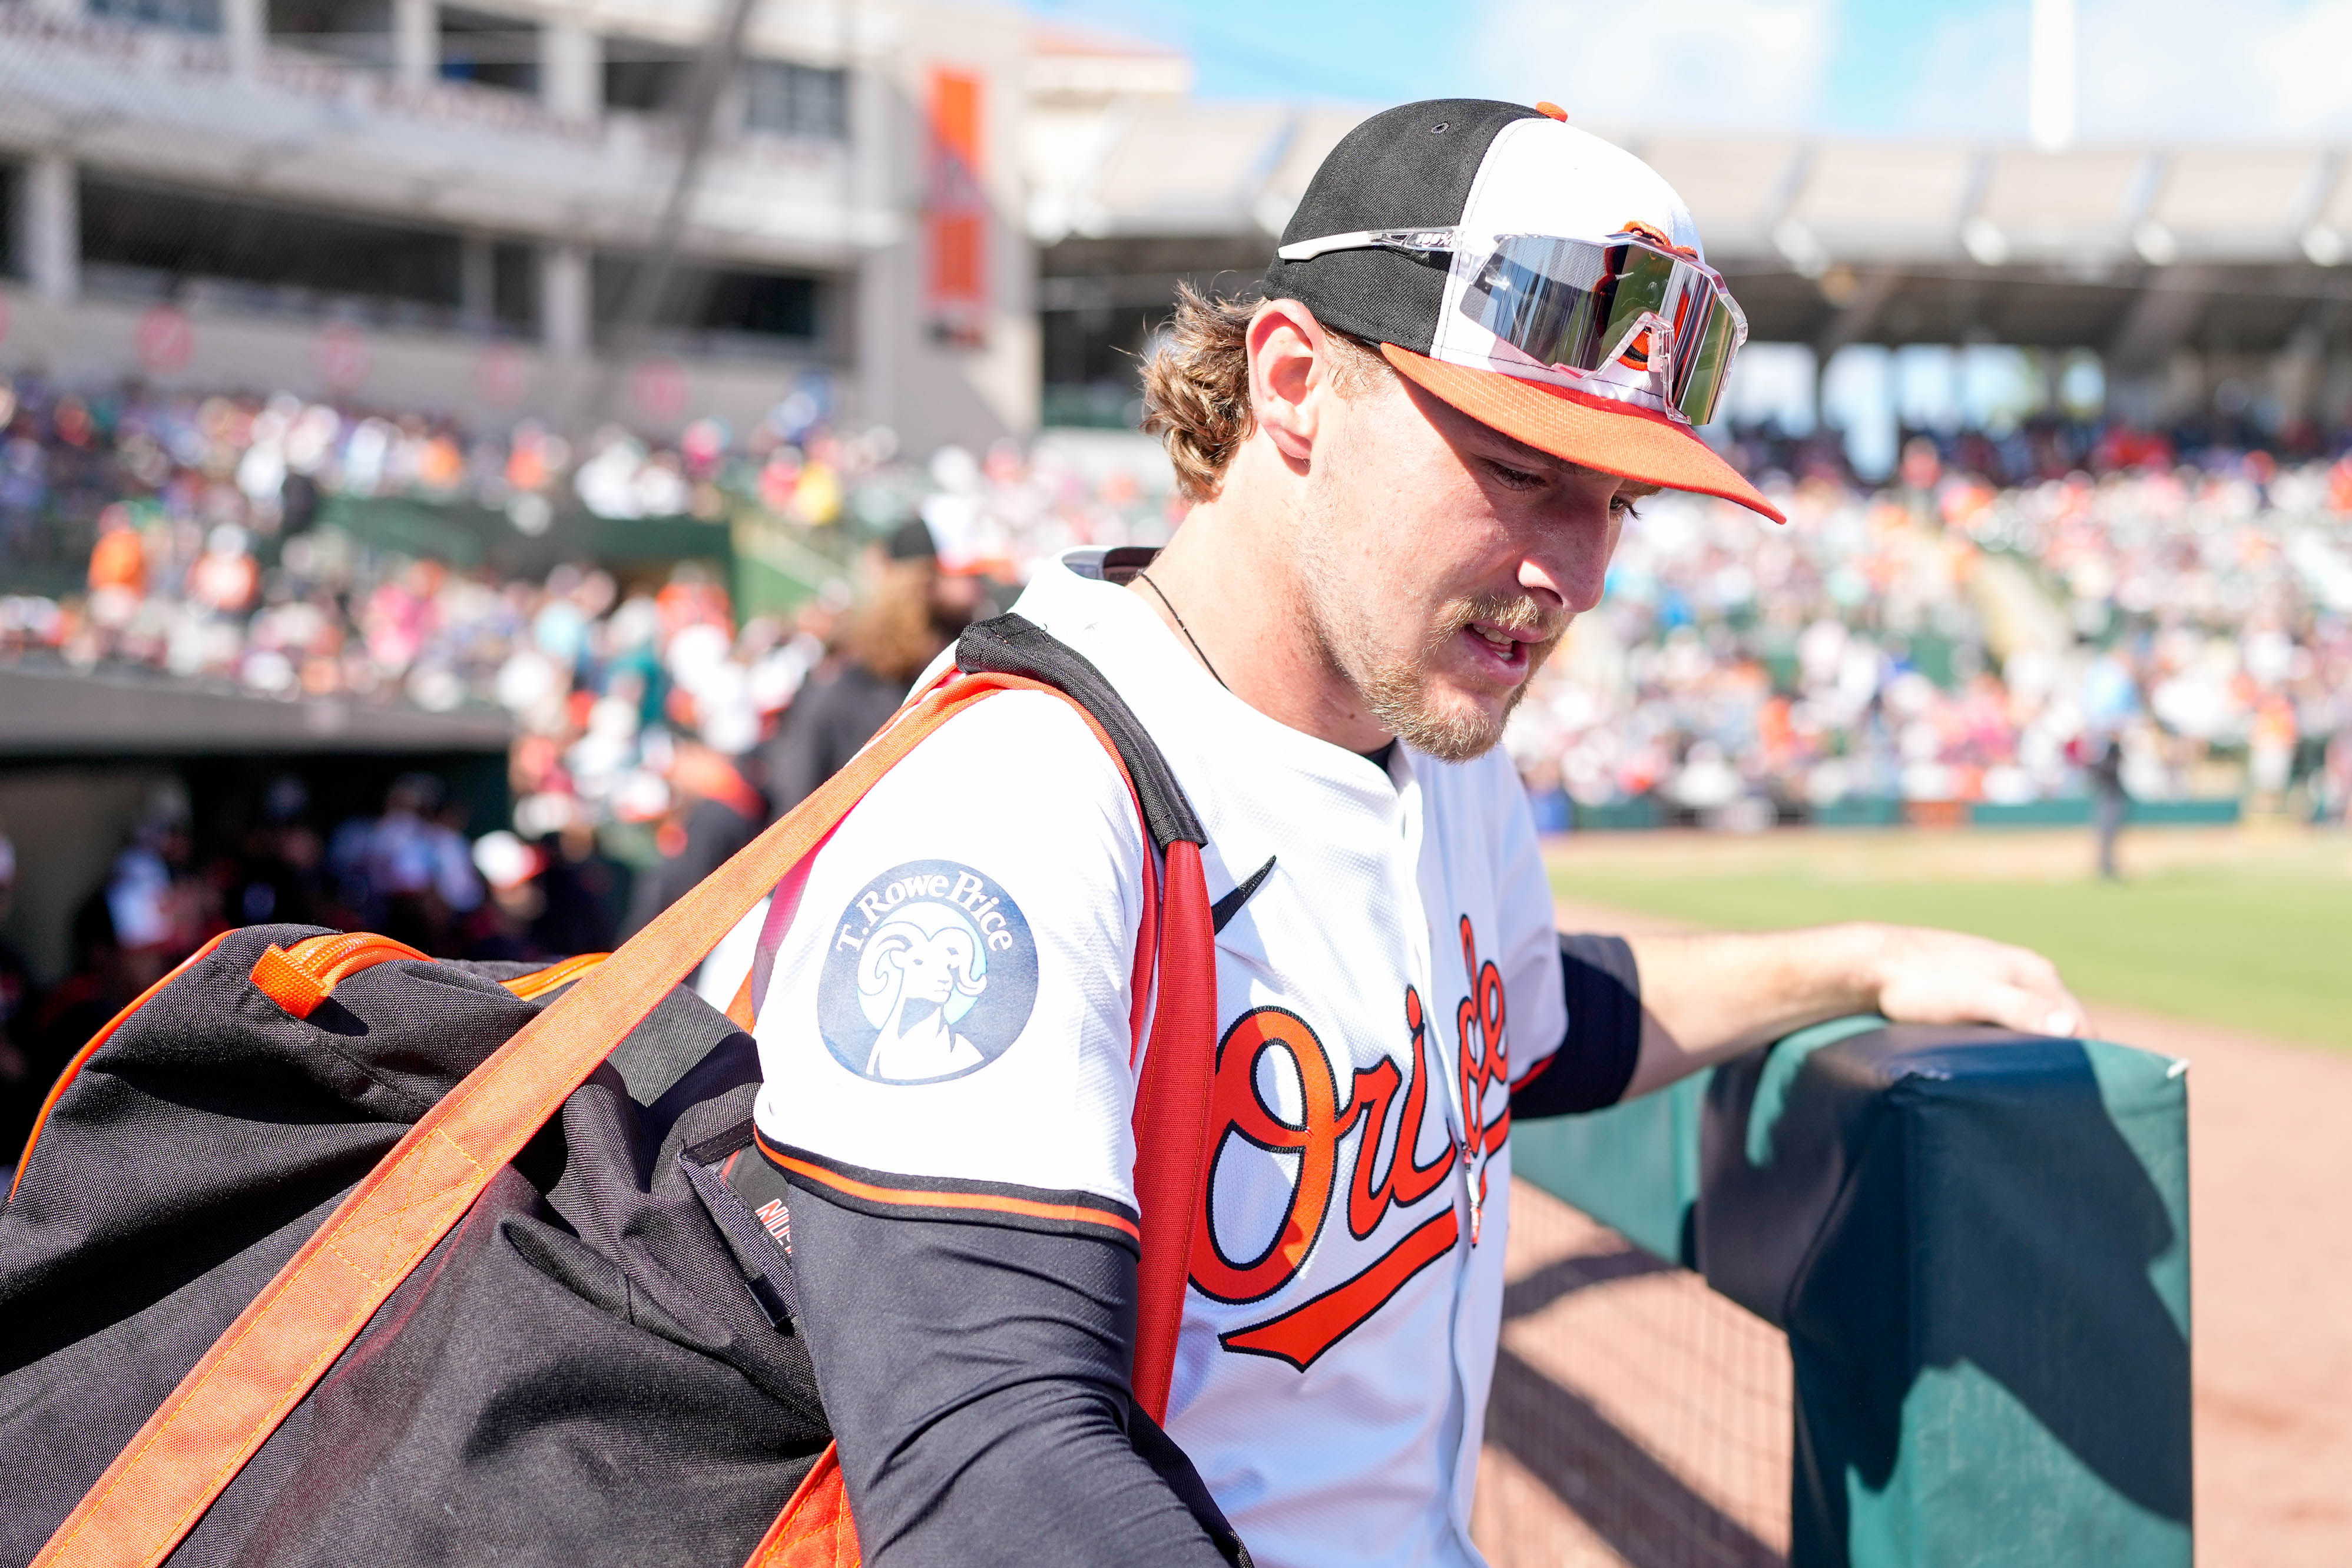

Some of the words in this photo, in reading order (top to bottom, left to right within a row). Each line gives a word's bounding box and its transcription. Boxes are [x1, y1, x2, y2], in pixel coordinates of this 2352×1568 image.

[856, 874, 949, 924] Rowe
[945, 870, 1013, 952] Price
[1188, 913, 1509, 1305] Oriole
